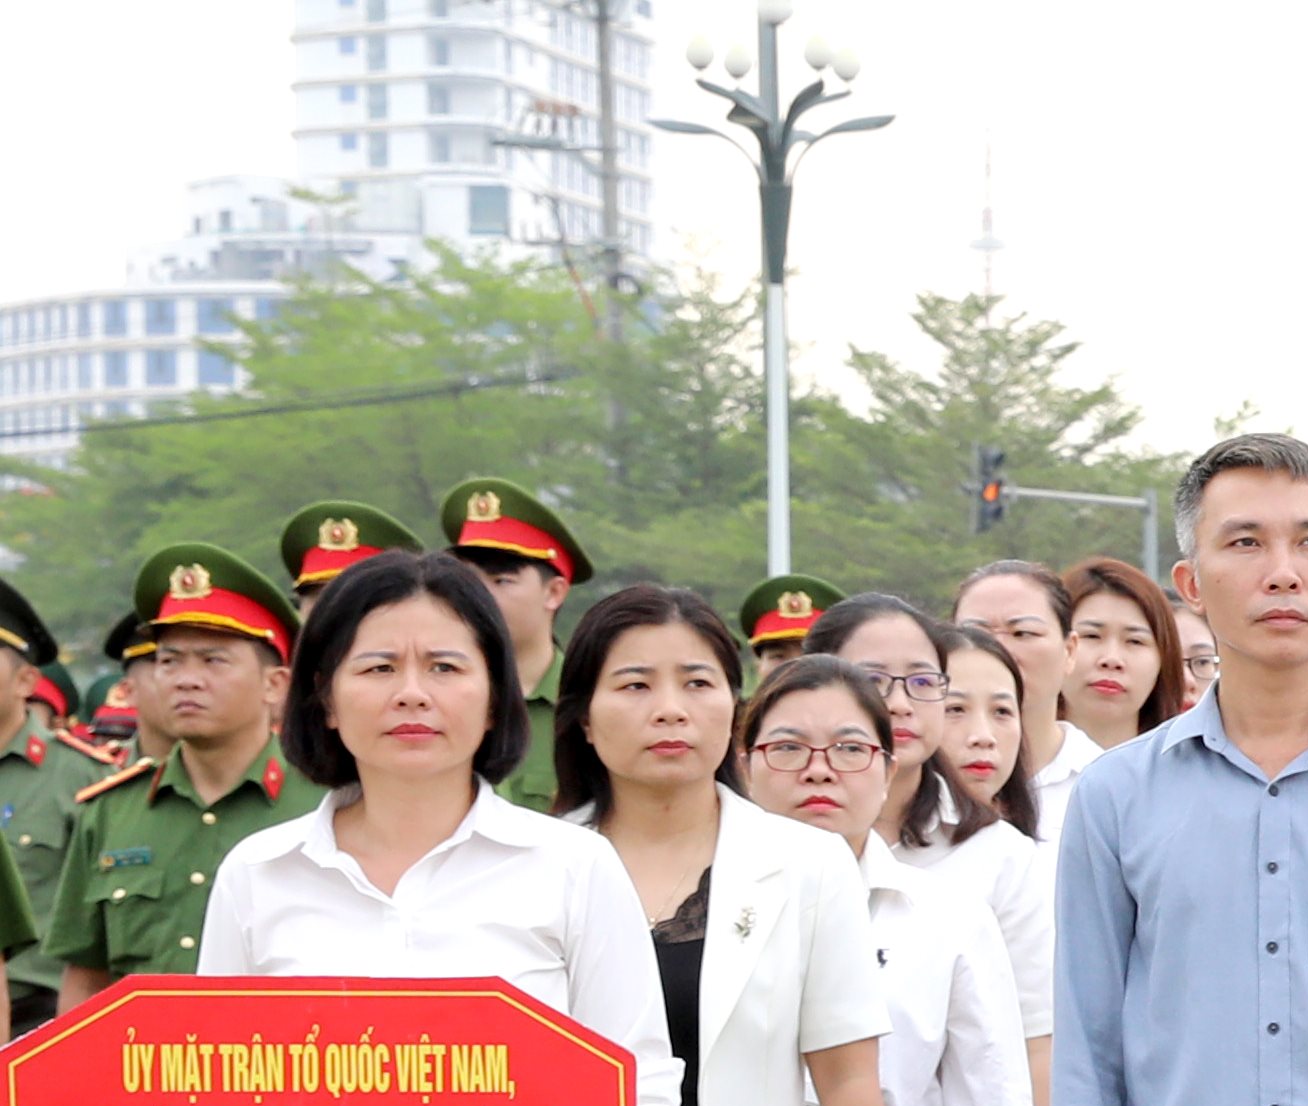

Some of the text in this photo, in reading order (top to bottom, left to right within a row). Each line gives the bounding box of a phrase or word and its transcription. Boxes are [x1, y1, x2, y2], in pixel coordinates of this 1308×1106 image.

[123, 1025, 516, 1104] ỦY MẶT TRẬN TỔ QUỐC VIỆT NAM,
